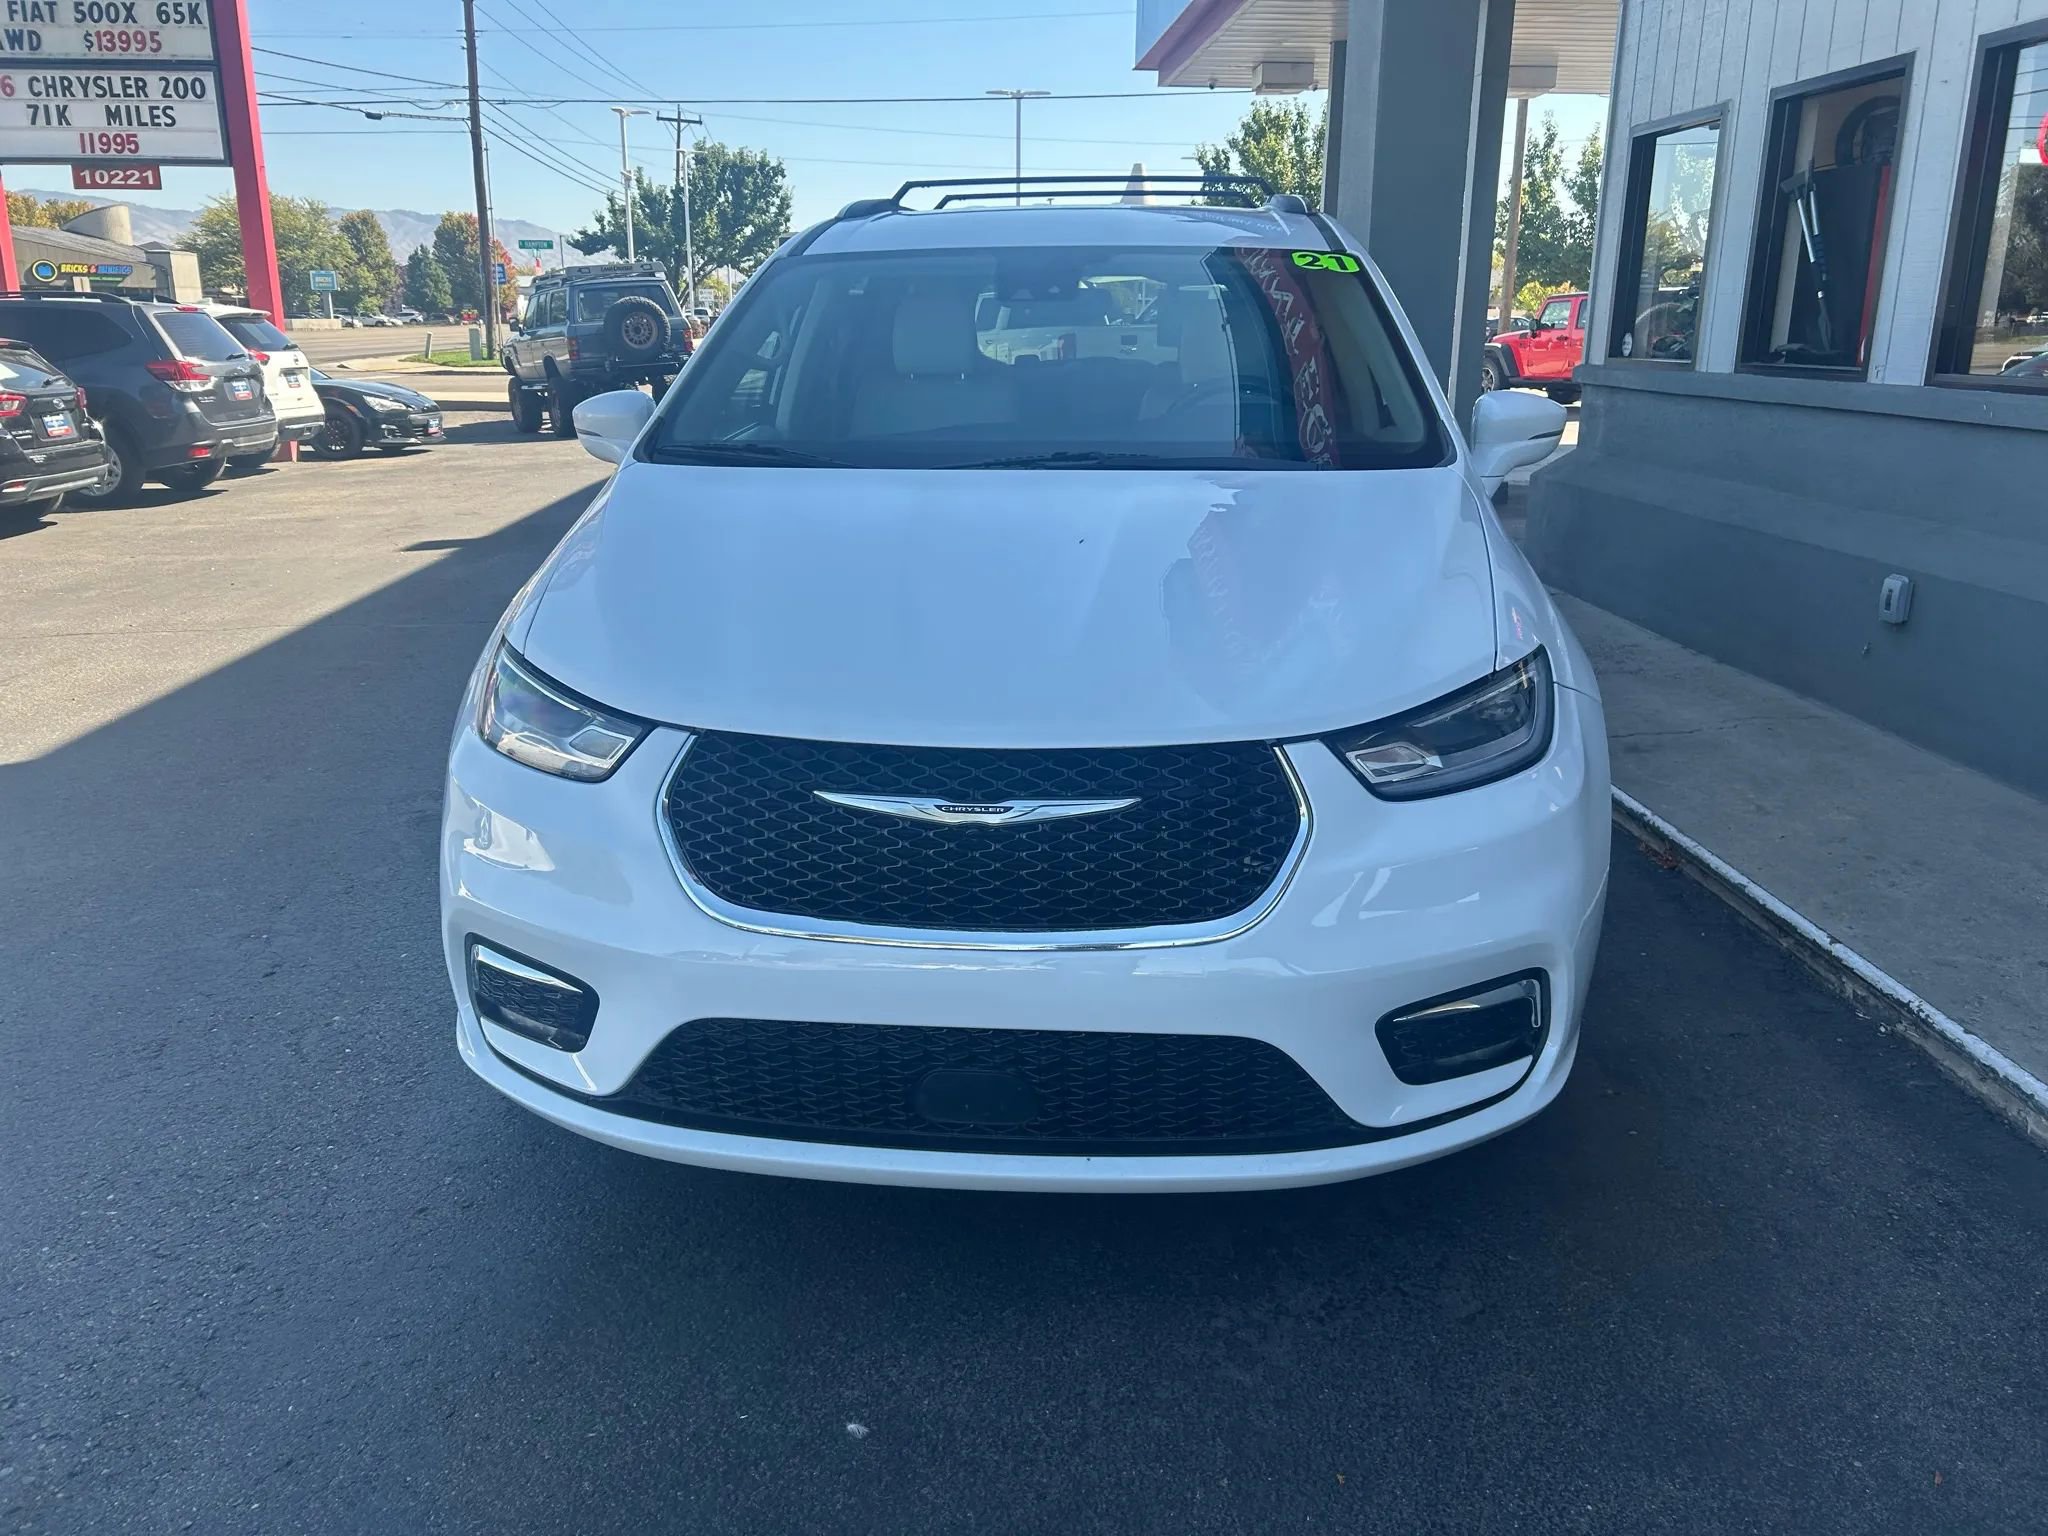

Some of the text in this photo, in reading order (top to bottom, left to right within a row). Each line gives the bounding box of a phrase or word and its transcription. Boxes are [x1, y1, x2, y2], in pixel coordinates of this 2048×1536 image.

[8, 1, 203, 25] FIAT 500X 65K
[83, 30, 162, 53] $13995
[28, 75, 149, 99] CHRYSLER
[158, 76, 206, 99] 200
[26, 104, 176, 128] 71K MILES
[79, 132, 140, 155] 11995
[79, 169, 154, 186] 10221
[60, 263, 89, 273] BRICKS
[1297, 253, 1350, 271] 21
